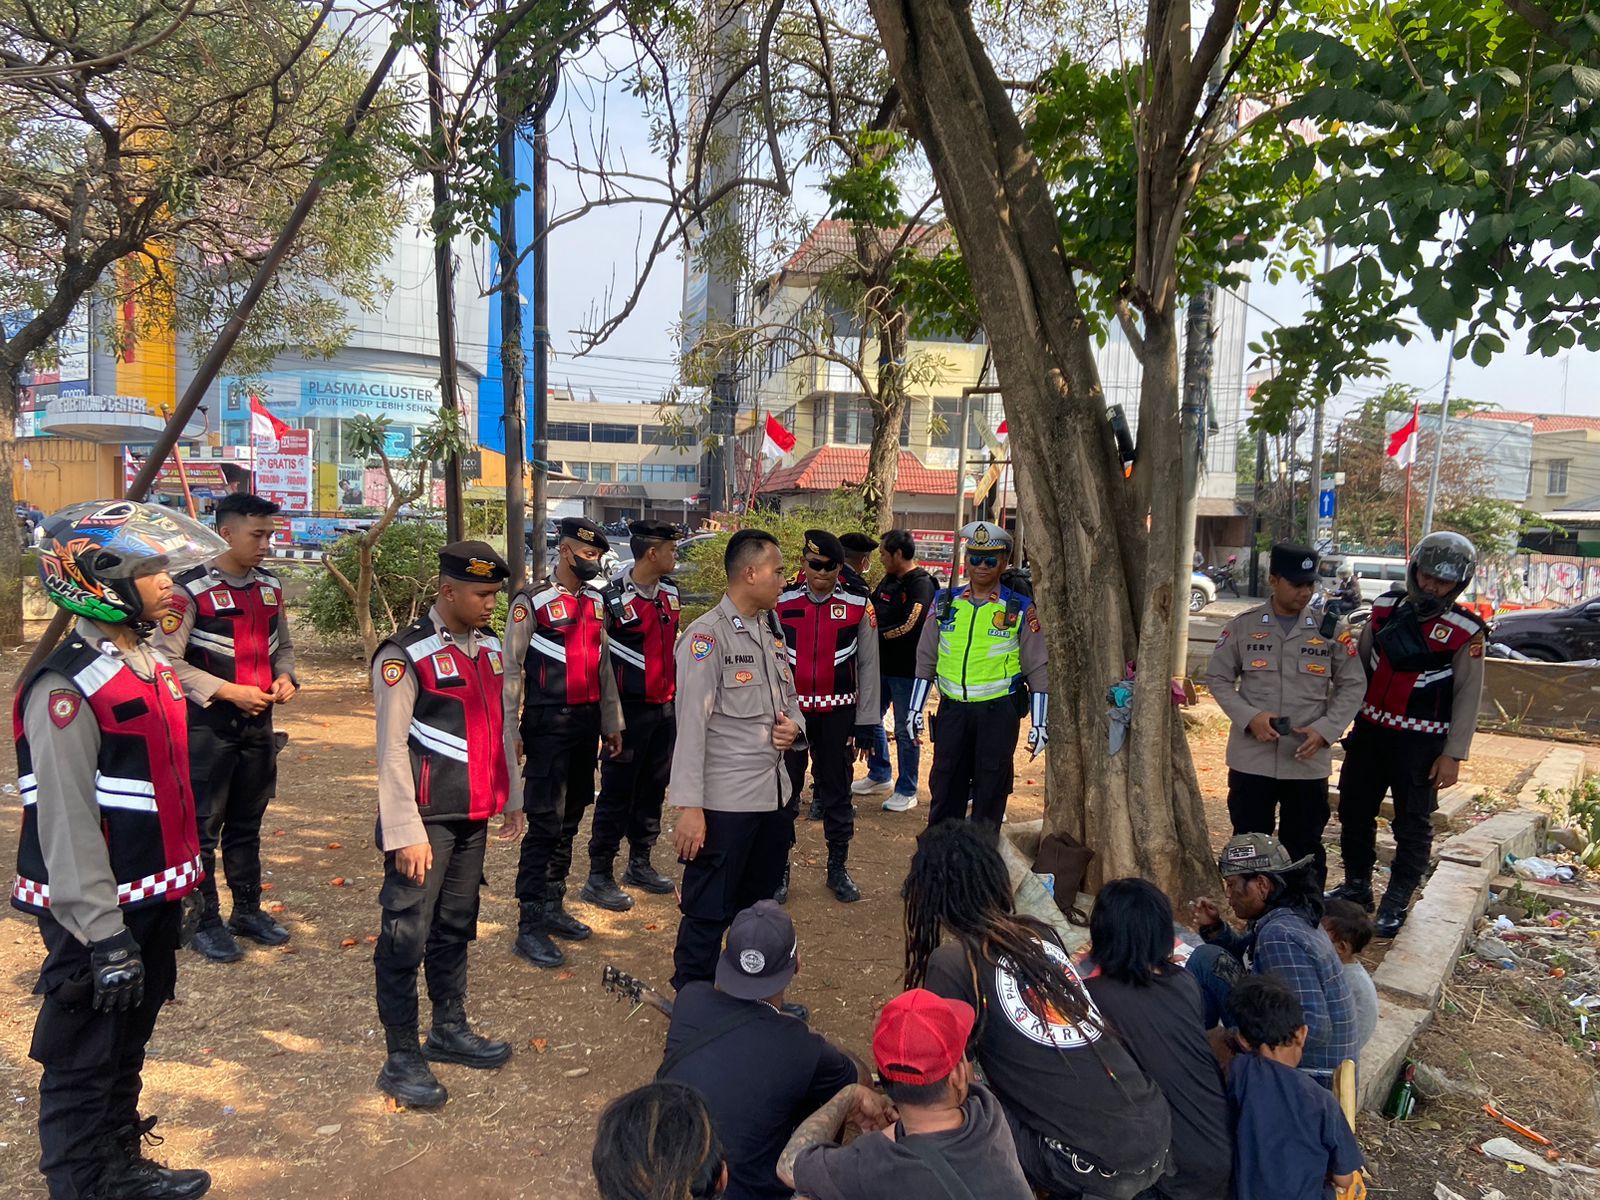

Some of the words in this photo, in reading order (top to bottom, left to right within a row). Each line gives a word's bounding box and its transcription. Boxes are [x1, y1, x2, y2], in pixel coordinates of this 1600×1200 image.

[308, 381, 434, 402] PLASMACLUSTER
[107, 395, 148, 413] CENTER
[308, 397, 338, 406] UNTUK
[341, 398, 373, 408] HIDUP
[375, 400, 404, 411] LEBIH
[267, 458, 297, 469] GRATIS
[45, 573, 96, 606] NHK
[1246, 644, 1273, 652] FERY
[1301, 647, 1330, 657] POLRI
[724, 655, 734, 665] H.
